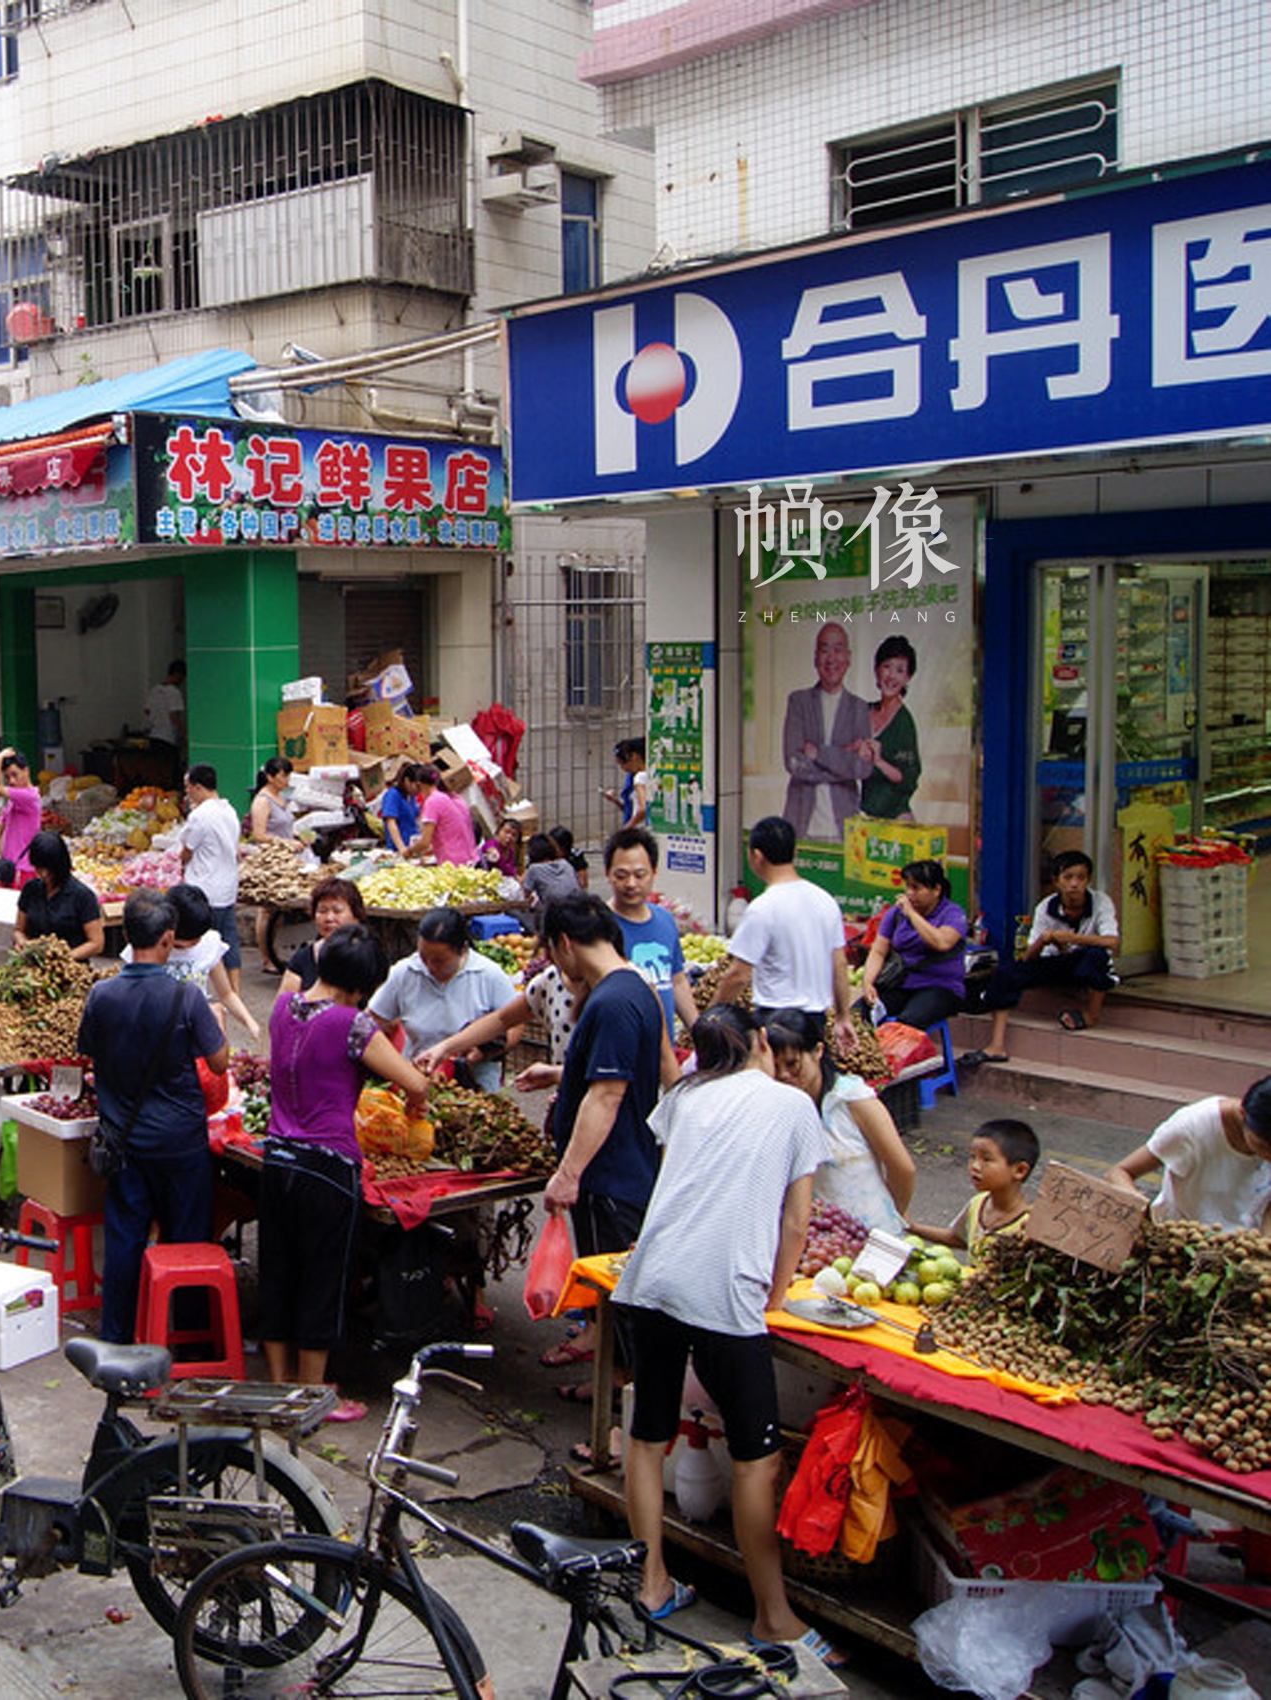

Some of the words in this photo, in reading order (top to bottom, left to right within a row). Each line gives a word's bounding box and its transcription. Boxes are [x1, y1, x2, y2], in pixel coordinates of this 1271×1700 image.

[782, 204, 1271, 432] 合丹医
[166, 425, 490, 516] 林记鲜果店
